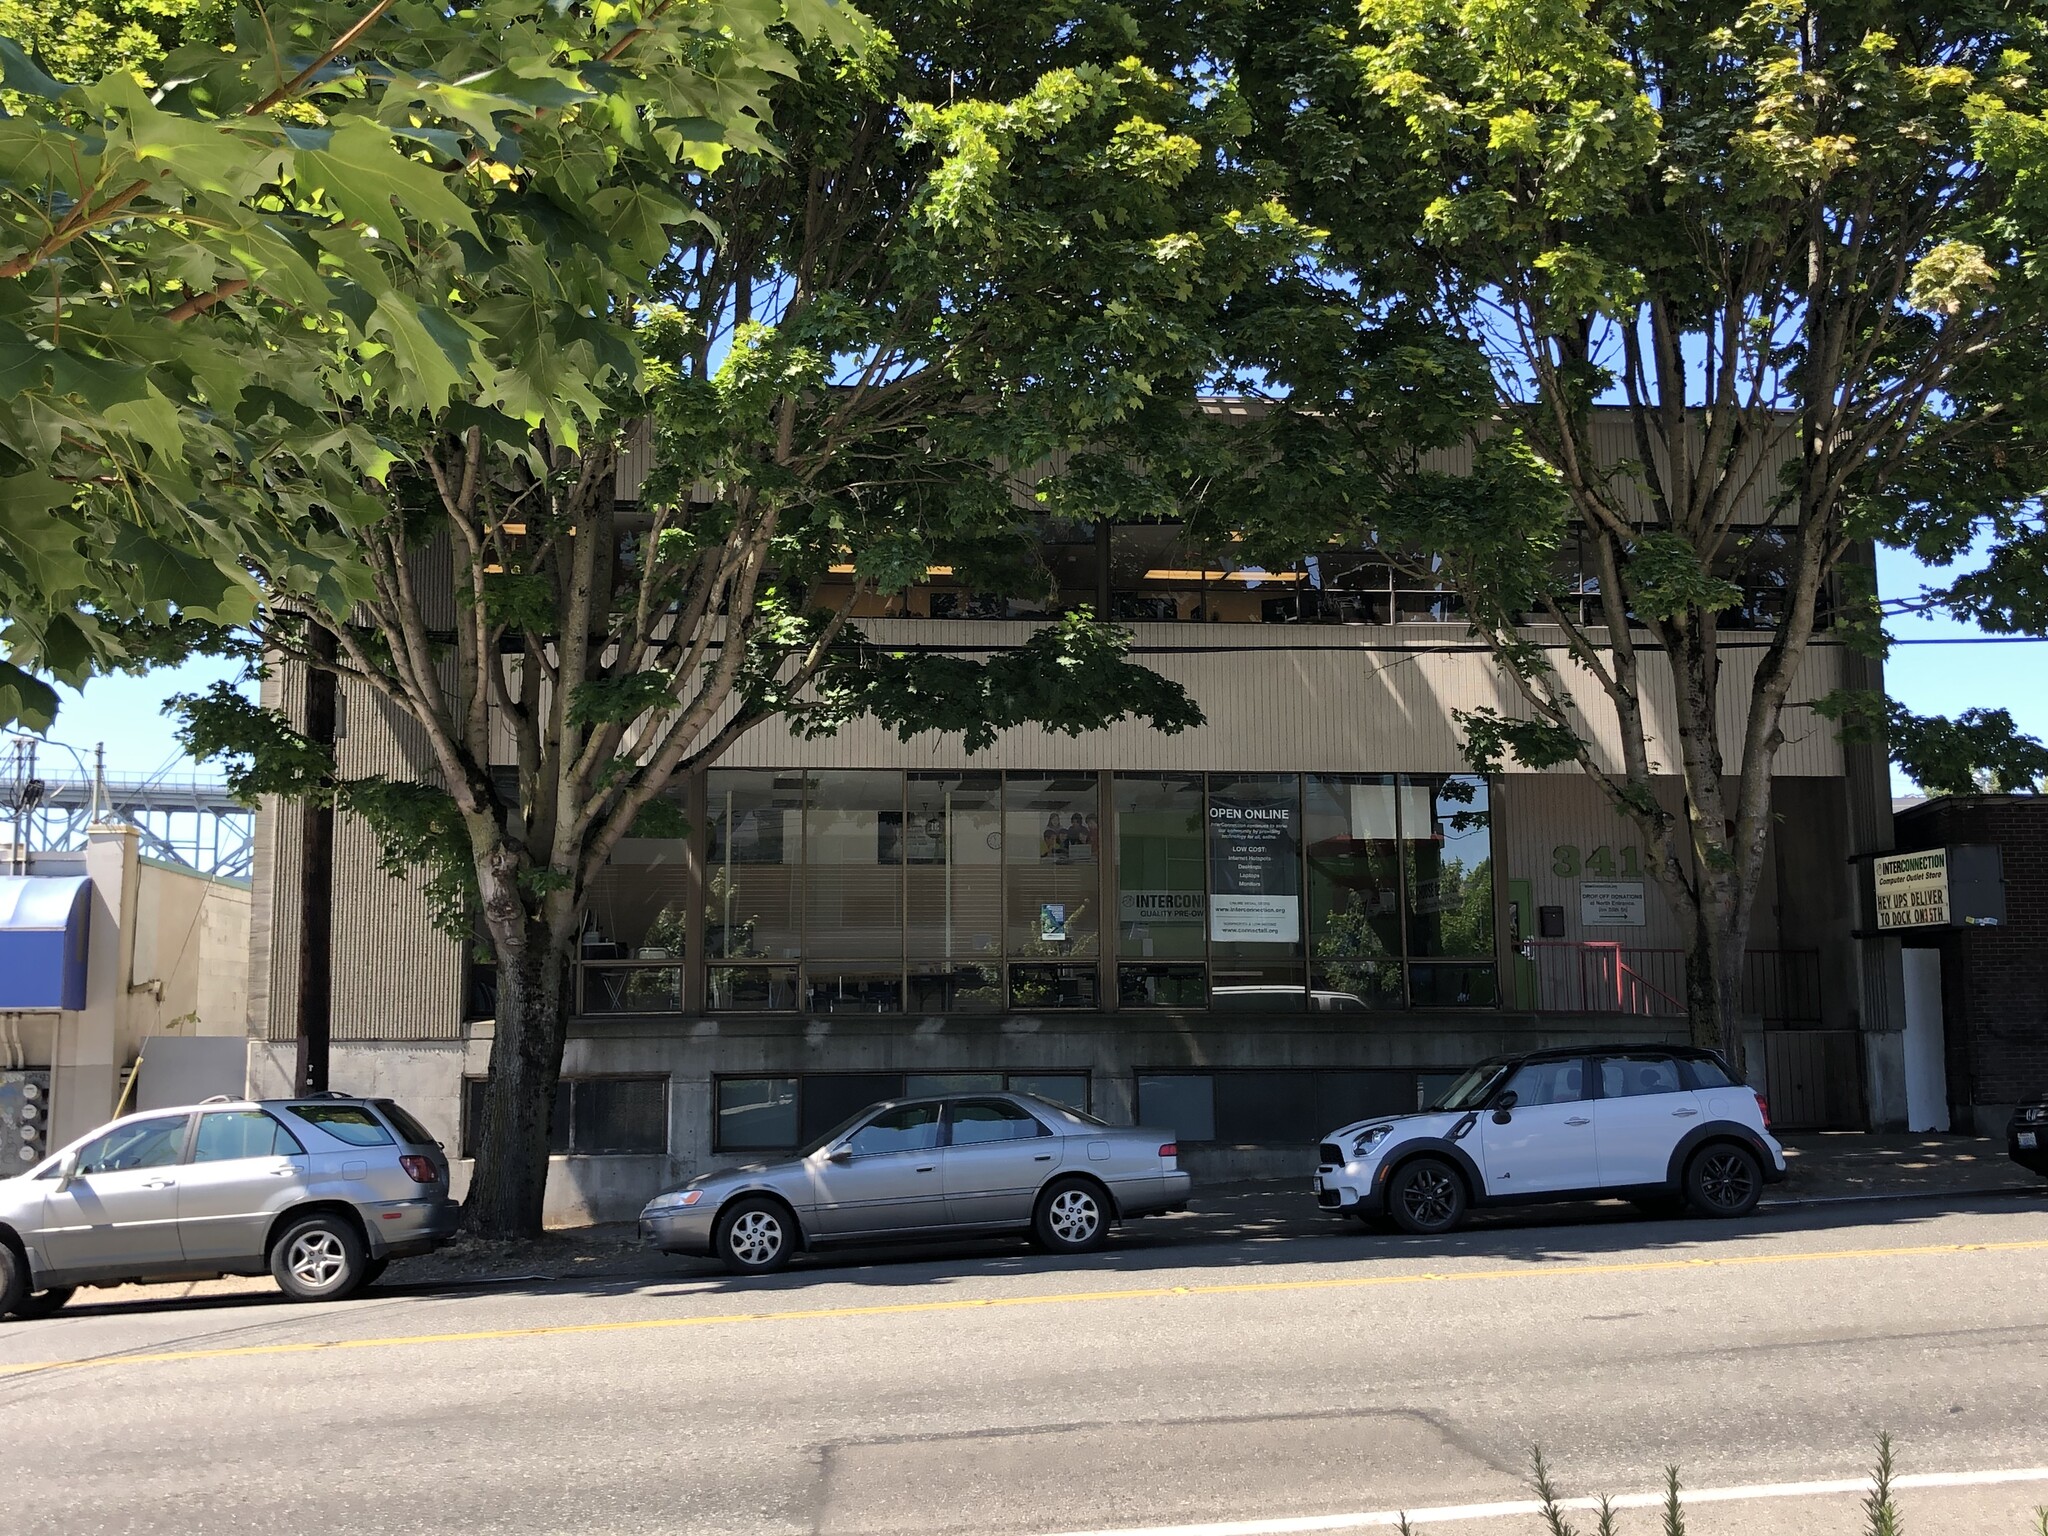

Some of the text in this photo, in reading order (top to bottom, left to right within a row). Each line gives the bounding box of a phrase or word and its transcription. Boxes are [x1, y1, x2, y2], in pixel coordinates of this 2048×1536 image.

[1209, 807, 1290, 820] OPEN ONLINE
[1882, 854, 1945, 875] INTERCONNECTION
[1879, 871, 1942, 886] Computer Outlet Store
[1877, 889, 1944, 911] HEY UPS DELIVER
[1140, 910, 1173, 918] QUALITY
[1880, 912, 1890, 926] TO
[1892, 909, 1911, 924] DOCK
